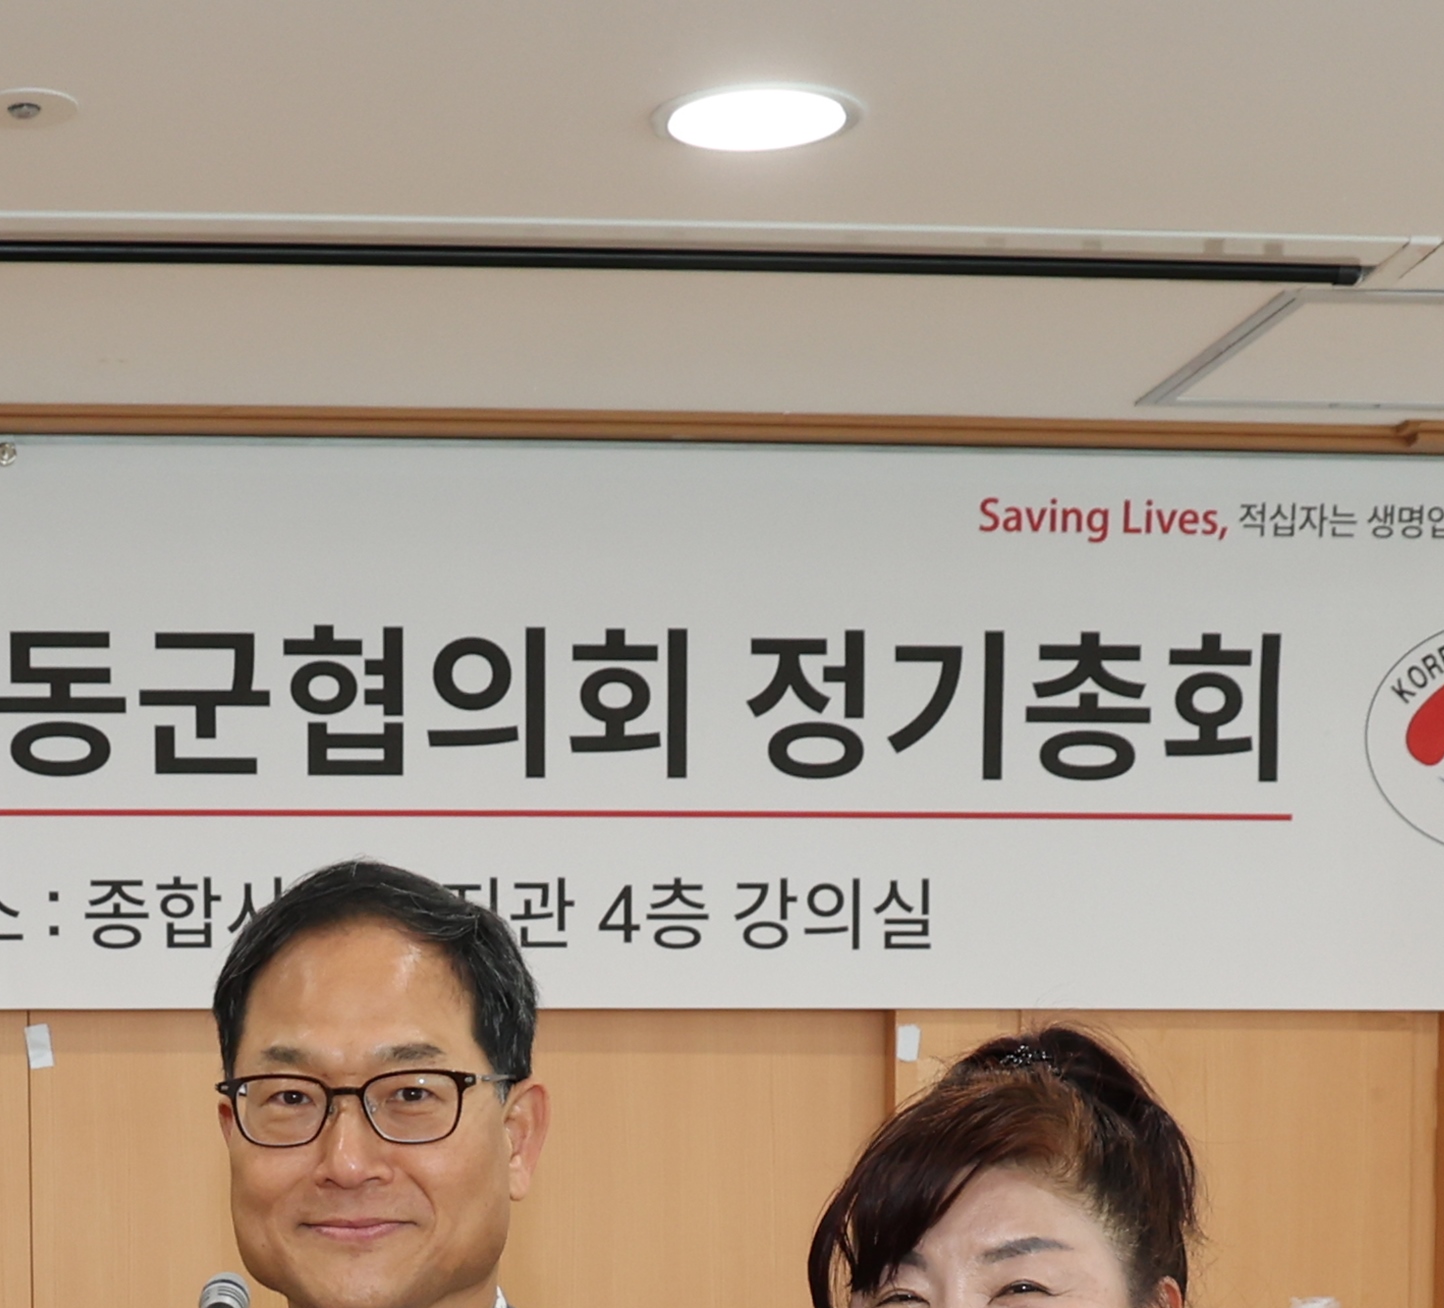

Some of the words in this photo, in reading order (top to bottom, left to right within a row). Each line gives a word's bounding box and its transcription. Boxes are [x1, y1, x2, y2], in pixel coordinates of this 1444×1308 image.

[978, 497, 1110, 543] Saving
[1121, 498, 1228, 542] Lives,
[1238, 502, 1358, 539] 적십자는
[744, 628, 1283, 783] 정기총회
[597, 877, 711, 950] 4층
[732, 877, 933, 951] 강의실
